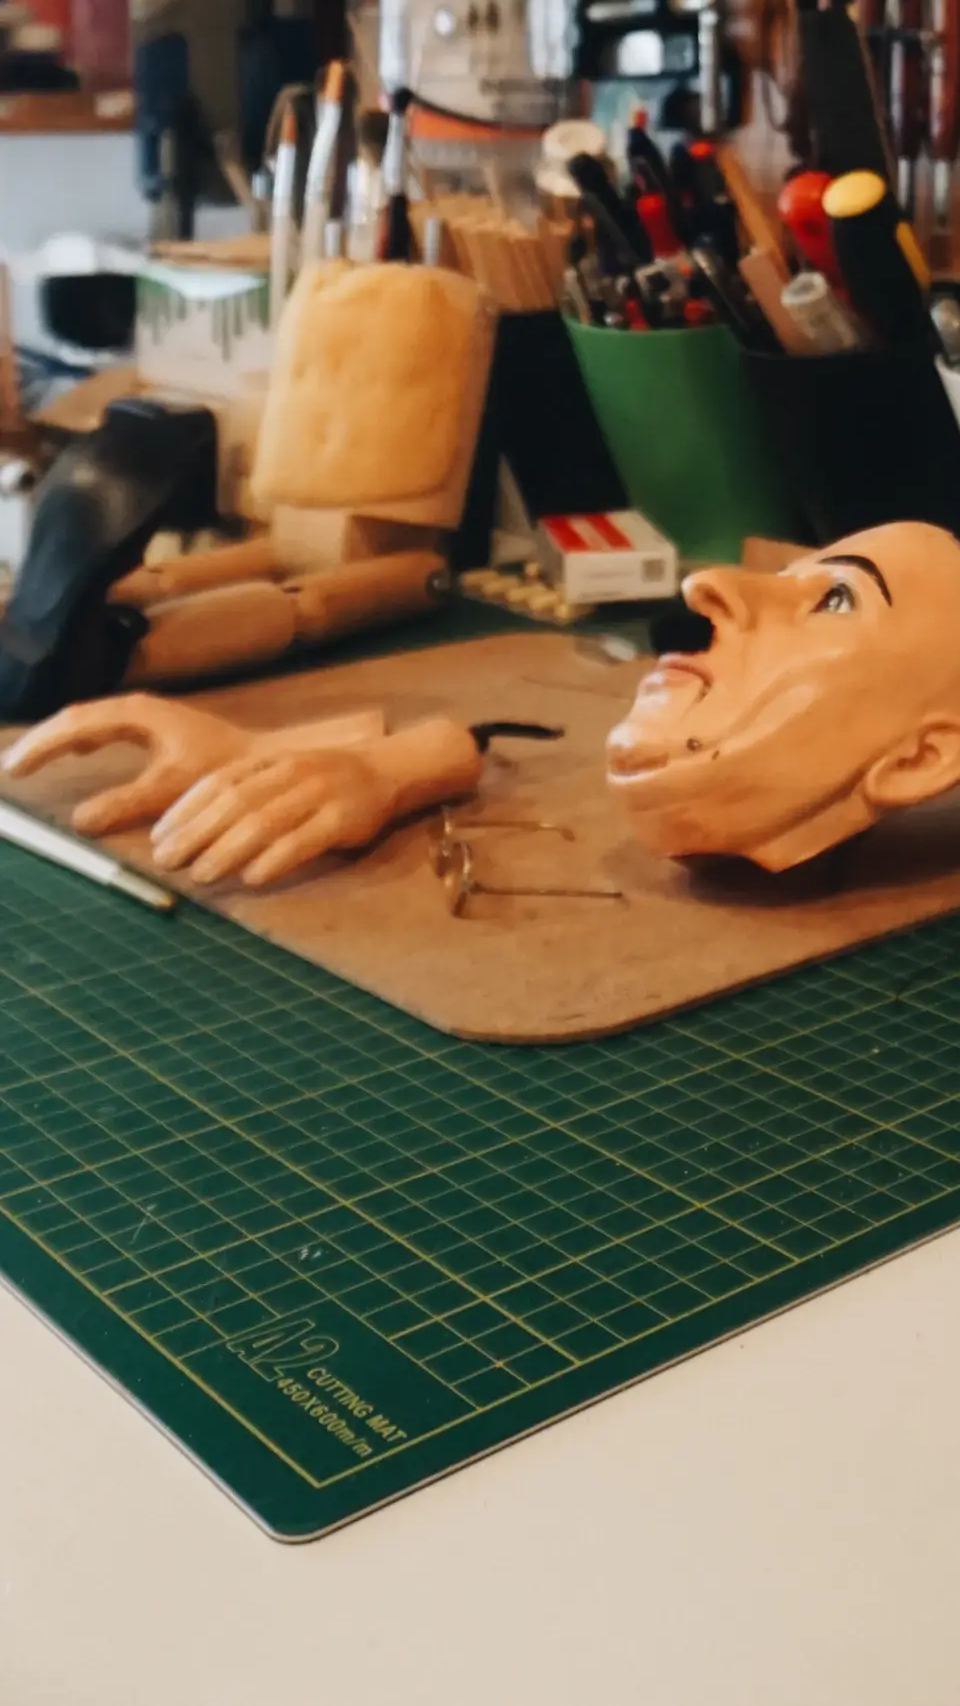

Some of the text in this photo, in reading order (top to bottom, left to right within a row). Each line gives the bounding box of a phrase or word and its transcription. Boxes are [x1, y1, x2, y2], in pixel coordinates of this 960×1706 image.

[226, 1318, 339, 1382] A2
[306, 1367, 408, 1442] CUTTING MAT
